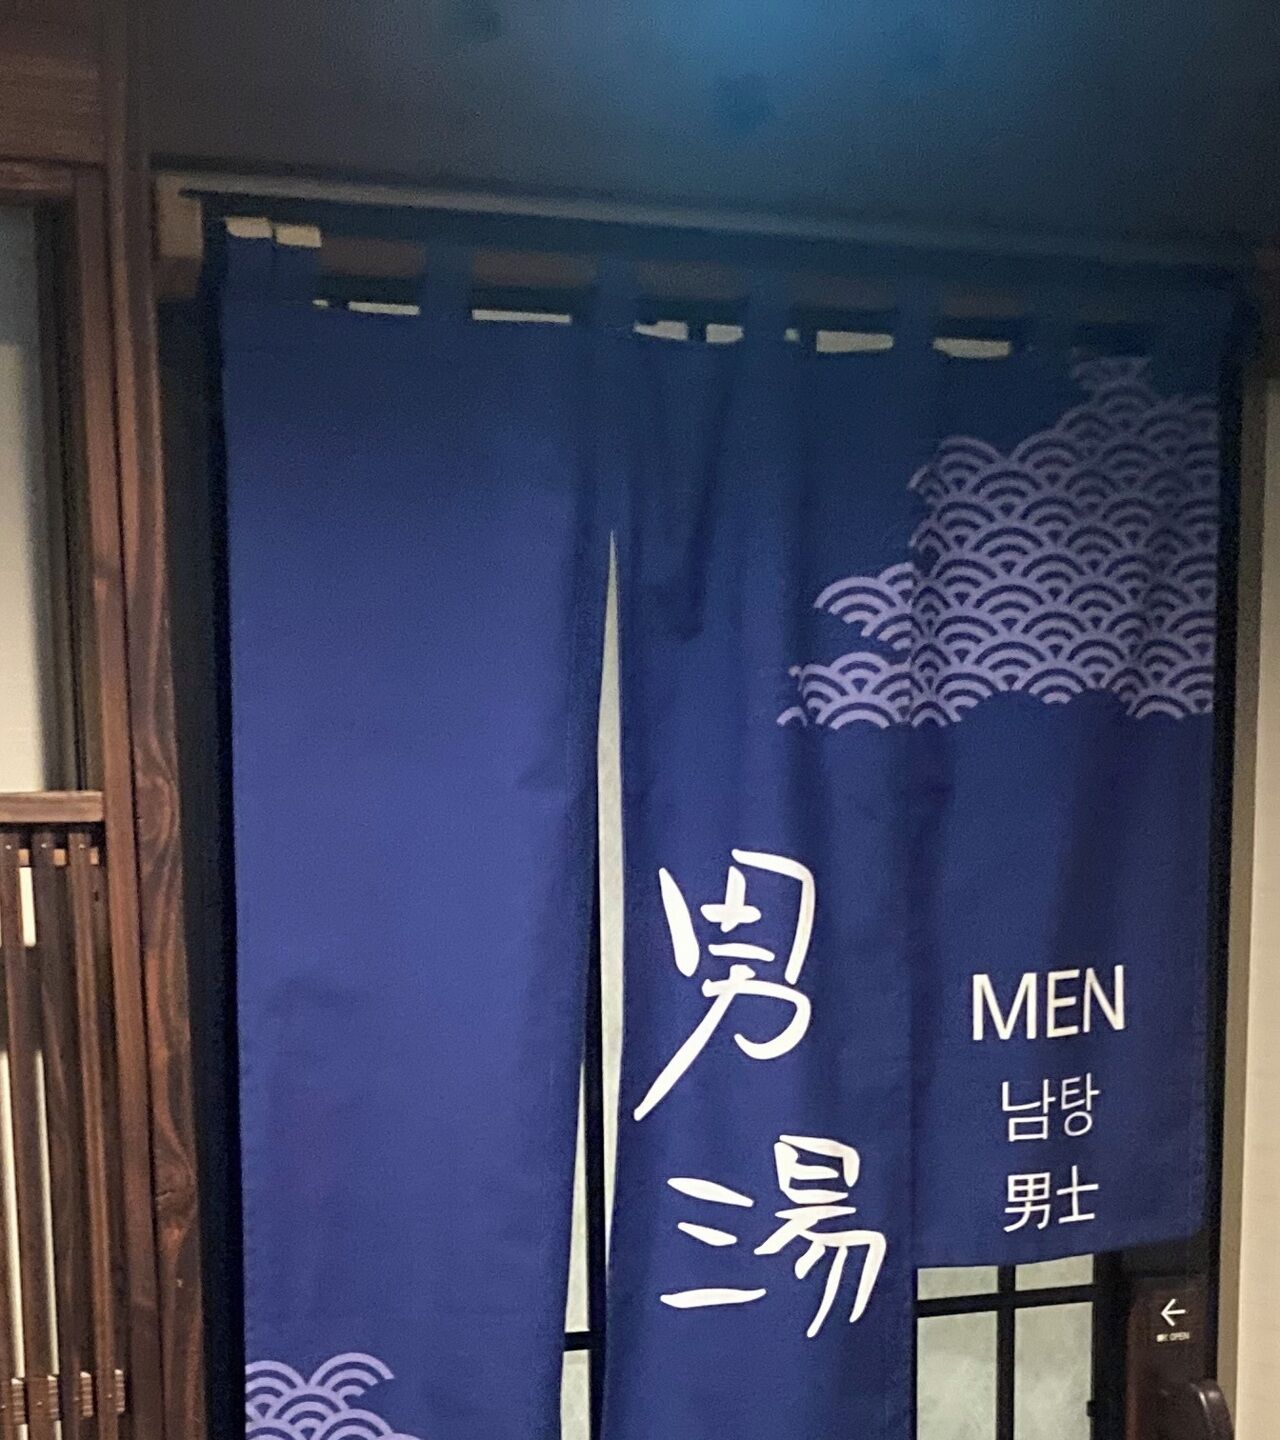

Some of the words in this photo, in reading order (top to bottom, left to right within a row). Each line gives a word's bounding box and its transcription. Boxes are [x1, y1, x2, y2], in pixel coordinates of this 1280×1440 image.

[972, 965, 1126, 1042] MEN
[633, 847, 887, 1339] 男湯
[1001, 1072, 1101, 1143] 남탕
[1003, 1165, 1100, 1233] 男士
[1169, 1331, 1190, 1341] OPEN
